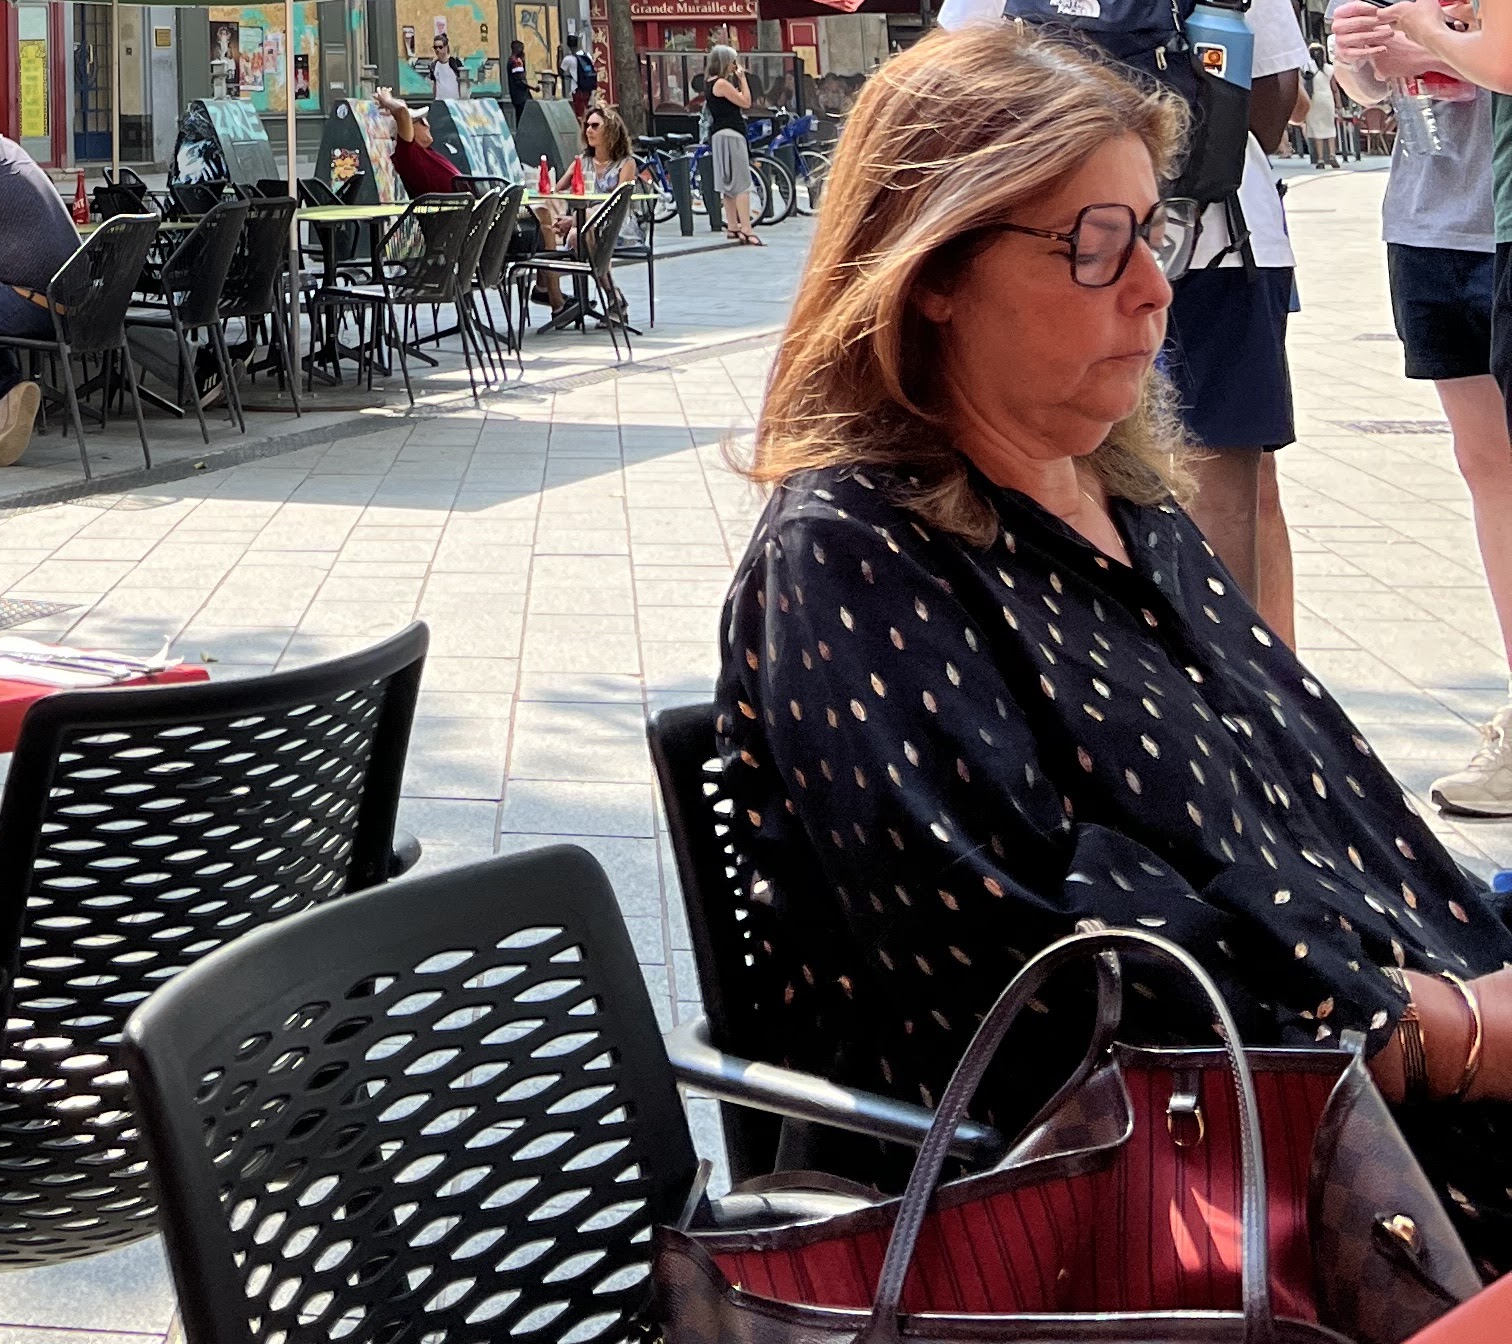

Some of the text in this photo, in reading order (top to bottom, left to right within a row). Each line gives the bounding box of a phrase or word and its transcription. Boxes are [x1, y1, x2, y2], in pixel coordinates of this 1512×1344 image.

[630, 2, 674, 14] Grande
[676, 1, 727, 13] Muraille
[729, 1, 744, 13] de
